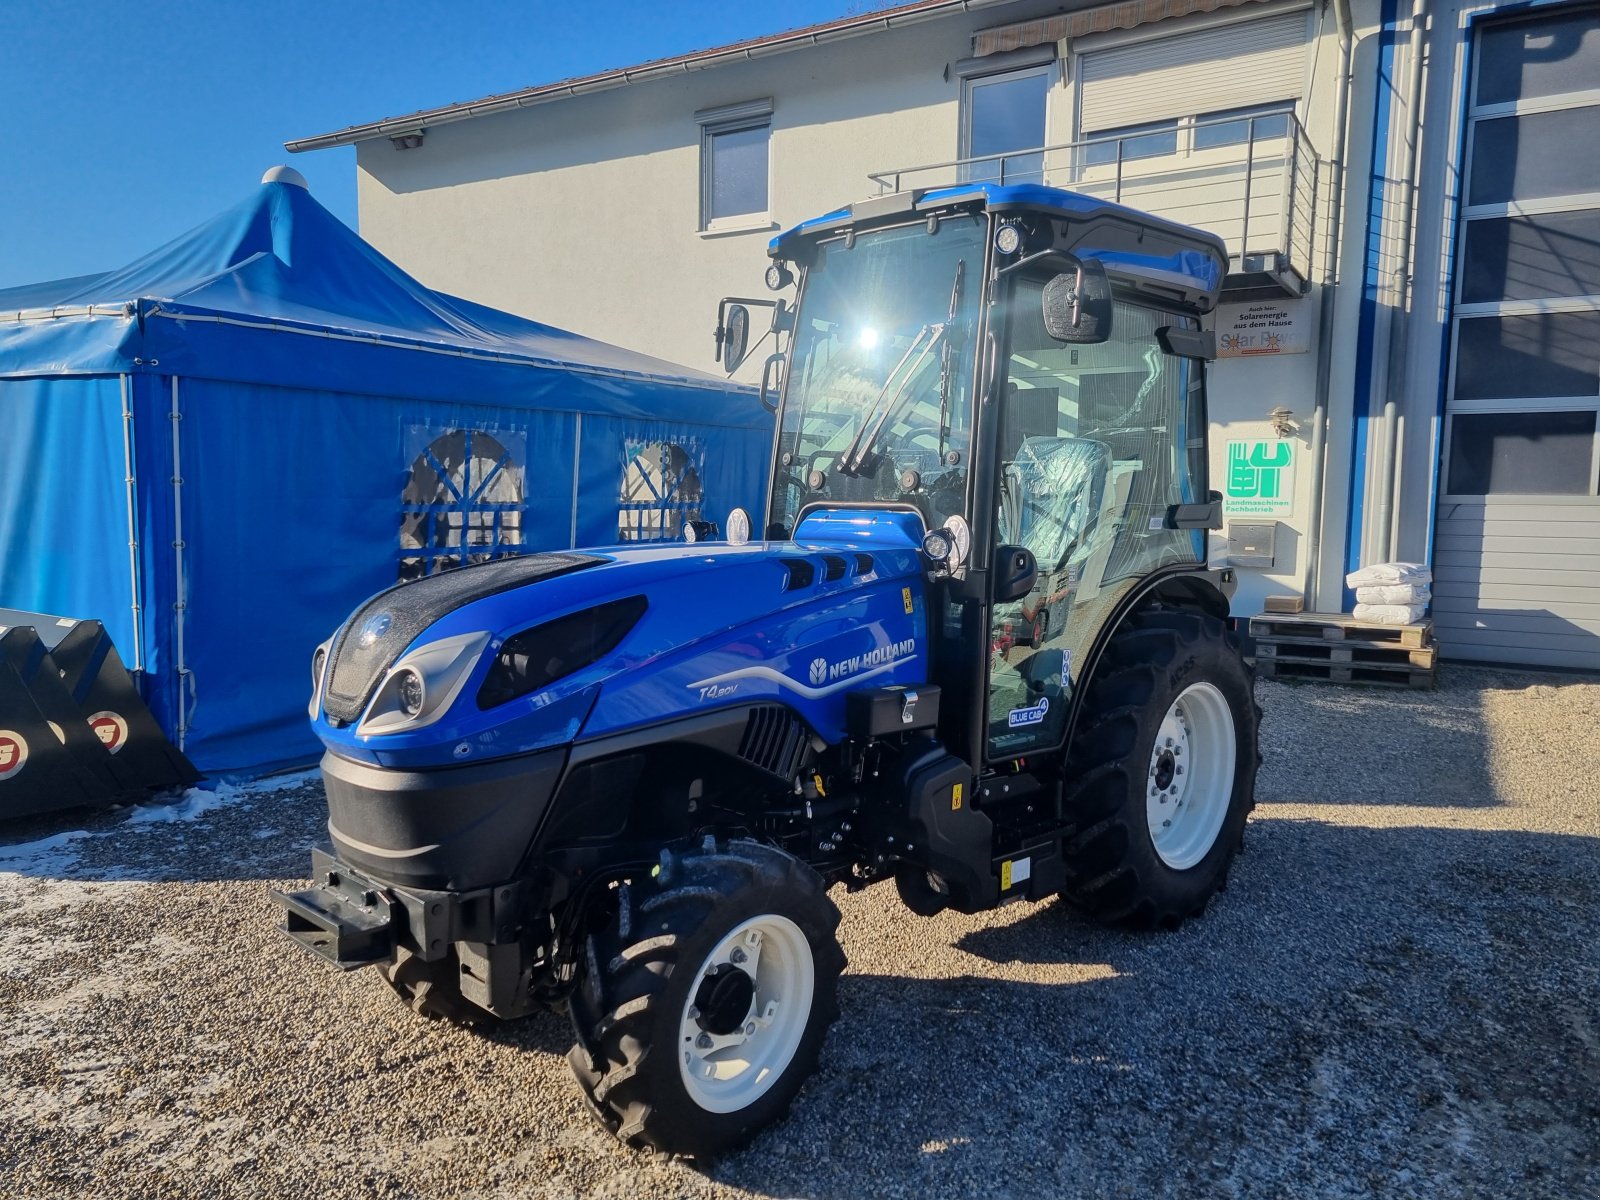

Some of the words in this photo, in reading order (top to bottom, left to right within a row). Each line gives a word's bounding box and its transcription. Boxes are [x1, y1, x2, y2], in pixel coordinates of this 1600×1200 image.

[1239, 311, 1288, 321] Solarenergie
[829, 658, 860, 680] NEW
[863, 638, 915, 667] HOLLAND
[1010, 712, 1028, 723] BLUE
[1028, 710, 1042, 720] CAB
